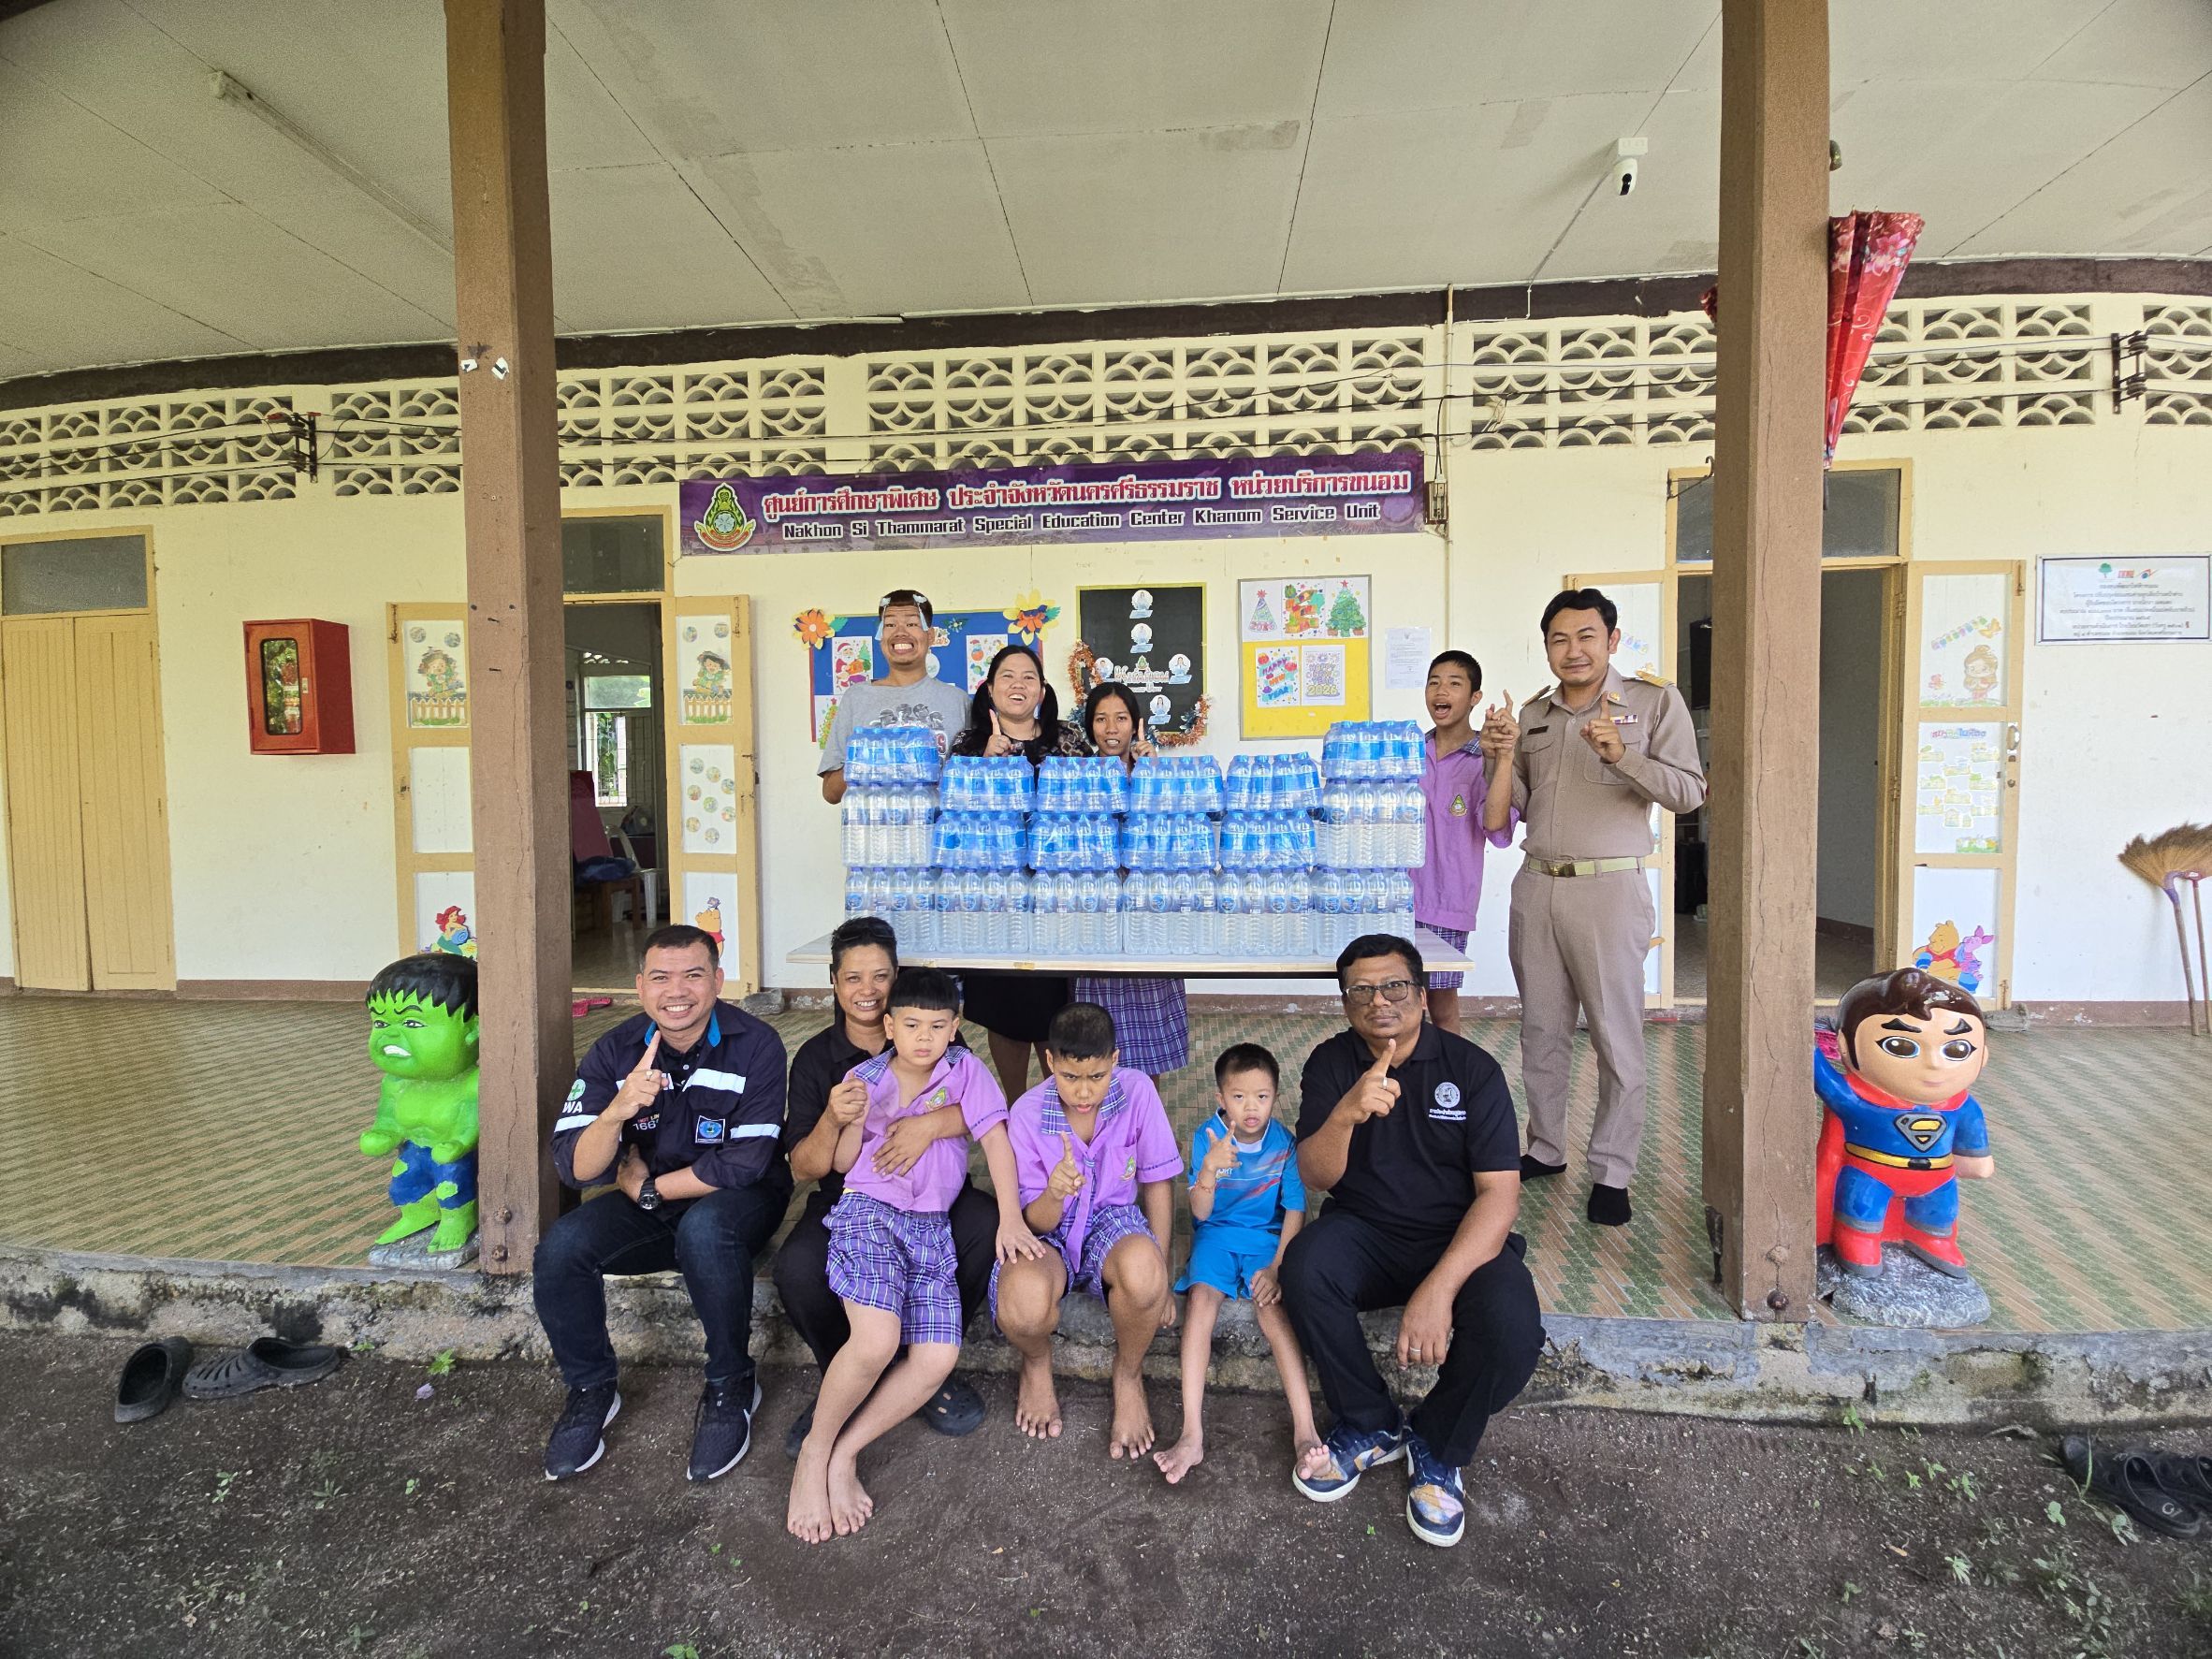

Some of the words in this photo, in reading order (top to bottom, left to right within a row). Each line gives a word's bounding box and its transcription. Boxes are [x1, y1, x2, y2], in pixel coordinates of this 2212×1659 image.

[764, 488, 938, 520] ศูนย์การศึกษาพิเศษ
[950, 478, 1219, 507] ประจำจังหวัดนครศรีธรรมราช
[1231, 473, 1408, 496] หน่วยบริการขนอม
[784, 524, 842, 538] Nakhon
[851, 522, 867, 536] Si
[877, 519, 964, 534] Thammarat
[975, 515, 1032, 533] Special
[1042, 514, 1120, 529] Education
[1130, 511, 1184, 526] Center
[1195, 509, 1261, 523] Khanom
[1273, 506, 1334, 521] Service
[1346, 503, 1379, 518] Unit
[1307, 684, 1338, 696] 2026
